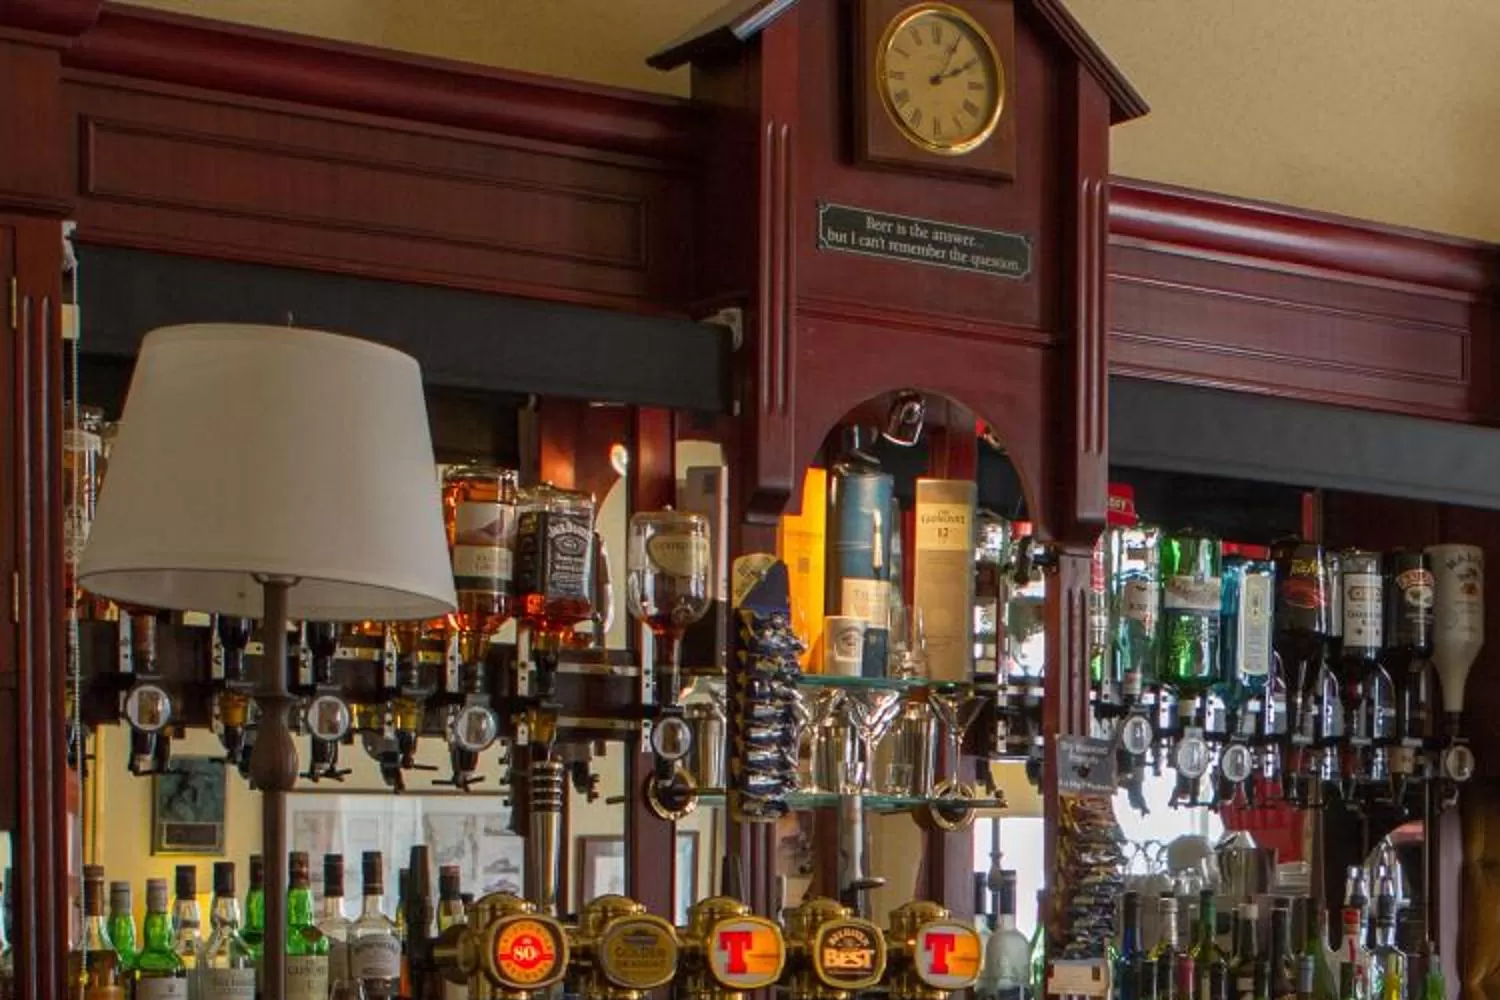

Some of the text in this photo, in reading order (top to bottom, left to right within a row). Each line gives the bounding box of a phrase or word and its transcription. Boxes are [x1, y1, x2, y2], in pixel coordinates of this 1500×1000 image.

[827, 226, 848, 245] but
[851, 229, 857, 245] I
[859, 232, 886, 250] can't
[888, 240, 947, 259] remember
[949, 245, 969, 263] the
[866, 215, 894, 233] Beer
[896, 221, 907, 236] is
[909, 222, 929, 239] the
[719, 931, 753, 974] T
[823, 947, 875, 969] BEST
[925, 933, 956, 974] T
